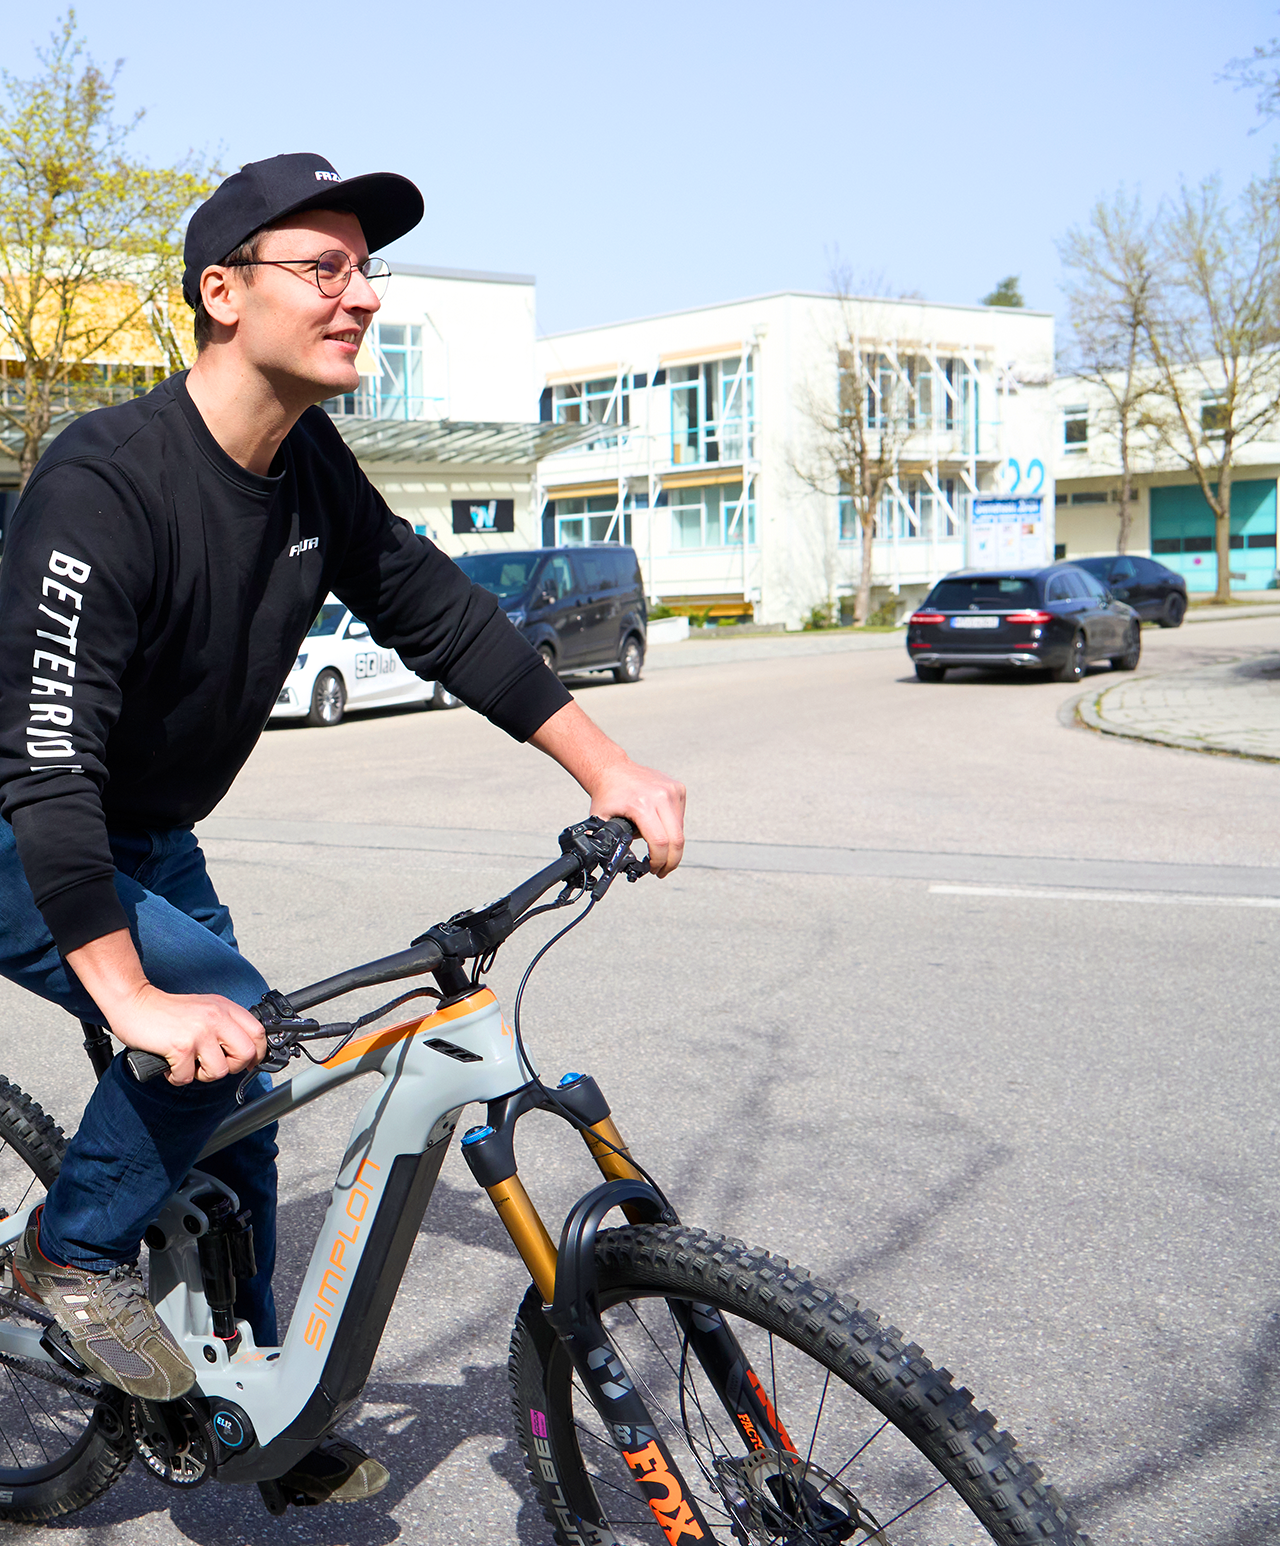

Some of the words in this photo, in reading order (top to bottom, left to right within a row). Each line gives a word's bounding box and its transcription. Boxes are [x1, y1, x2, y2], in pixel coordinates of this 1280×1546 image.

[314, 170, 341, 183] FAZ
[303, 1158, 381, 1352] SIMPLON
[737, 1413, 766, 1451] FACTO
[622, 1440, 705, 1546] FOX
